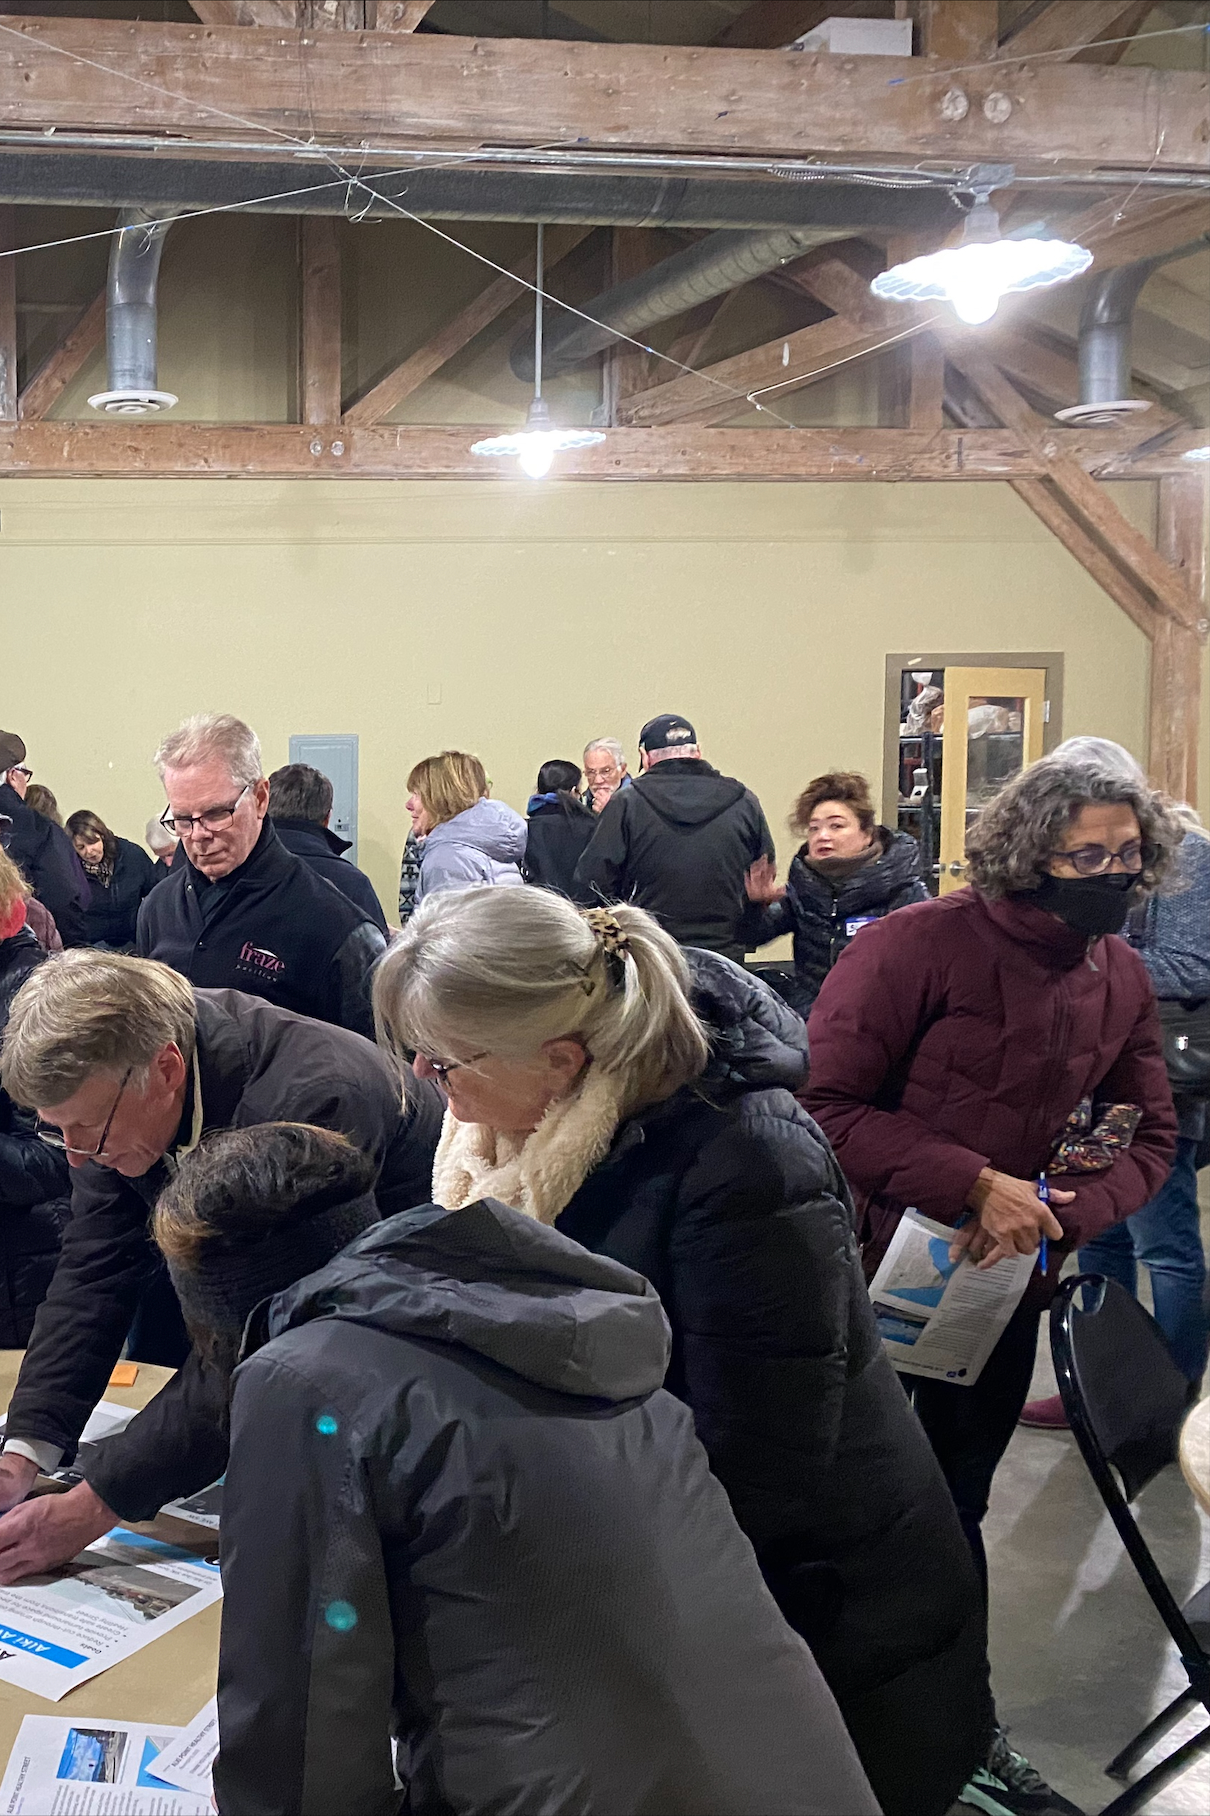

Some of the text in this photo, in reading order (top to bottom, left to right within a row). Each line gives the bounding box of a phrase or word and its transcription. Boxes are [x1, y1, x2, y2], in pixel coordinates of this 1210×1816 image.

[239, 940, 286, 973] fraze
[75, 1610, 129, 1631] Healthy Street
[12, 1635, 52, 1653] Alki
[76, 1633, 104, 1646] Reduce
[80, 1643, 102, 1654] Goals
